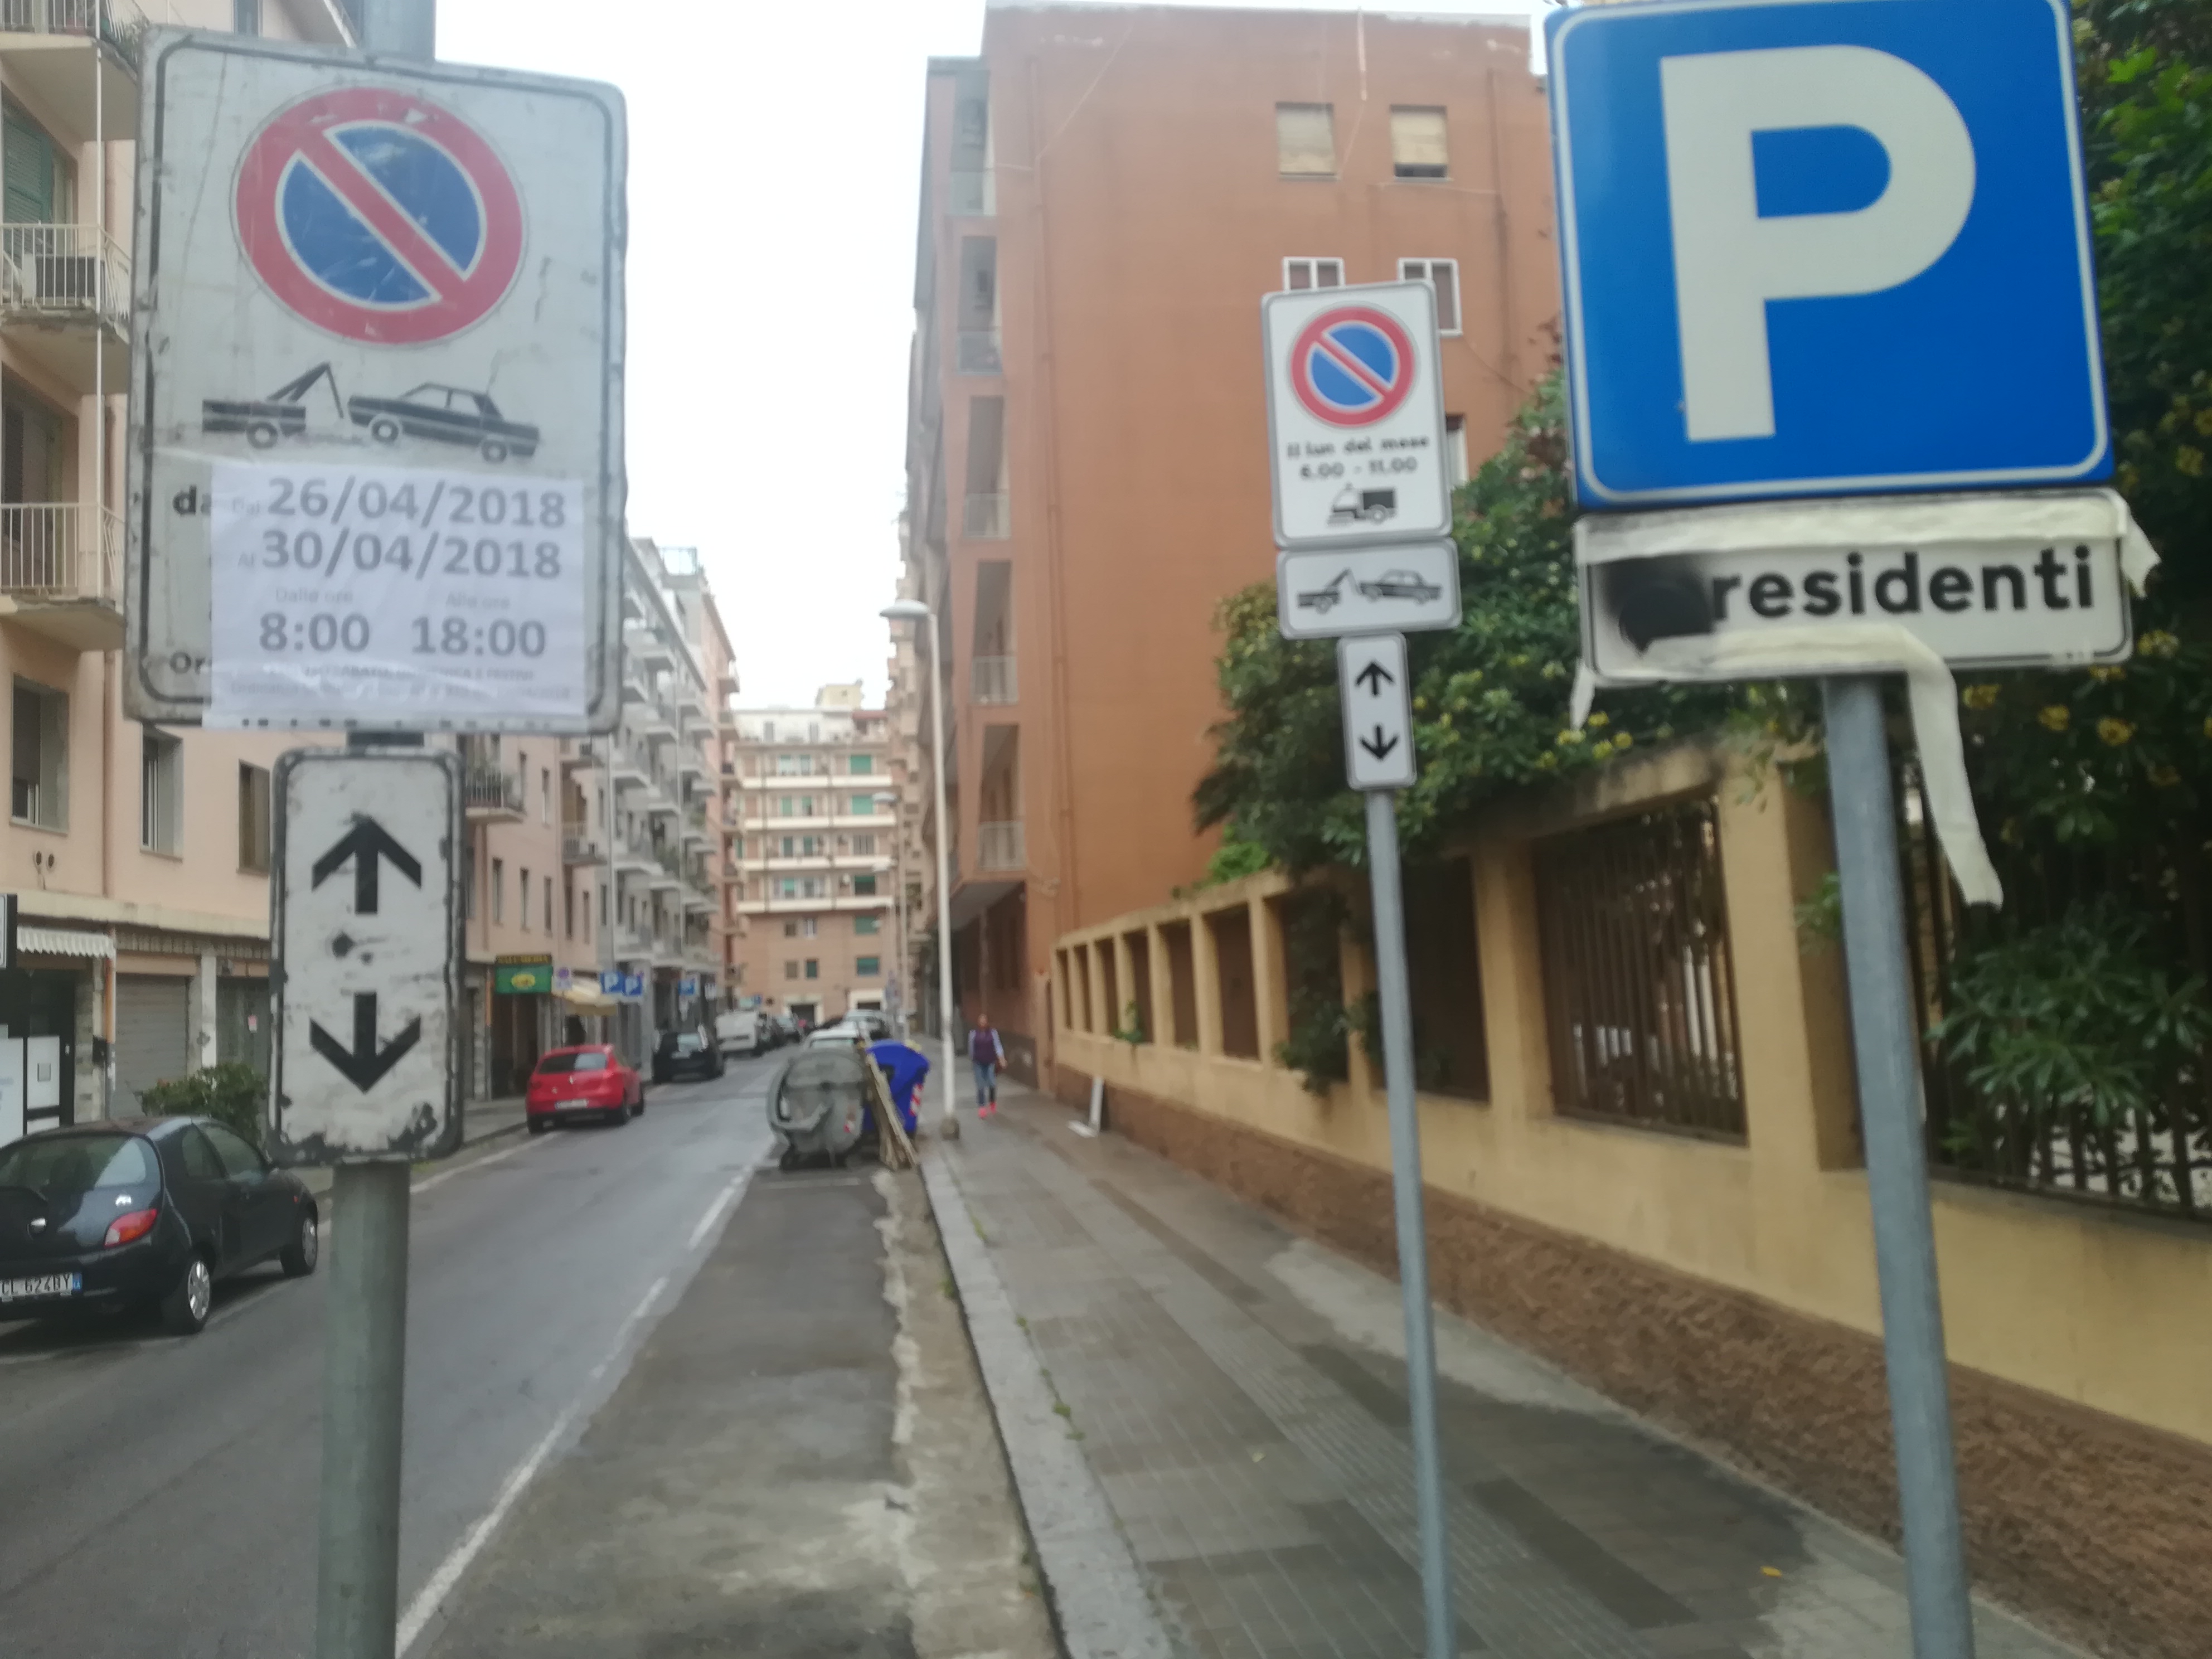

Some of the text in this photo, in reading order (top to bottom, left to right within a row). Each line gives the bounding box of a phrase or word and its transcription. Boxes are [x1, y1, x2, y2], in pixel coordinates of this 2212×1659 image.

[1660, 43, 1977, 444] P
[1343, 436, 1372, 453] del
[268, 475, 566, 528] 26/04/2018
[262, 526, 562, 580] 30/04/2018
[1711, 544, 2094, 620] residenti
[259, 612, 369, 652] 8:00
[411, 615, 546, 657] 18:00
